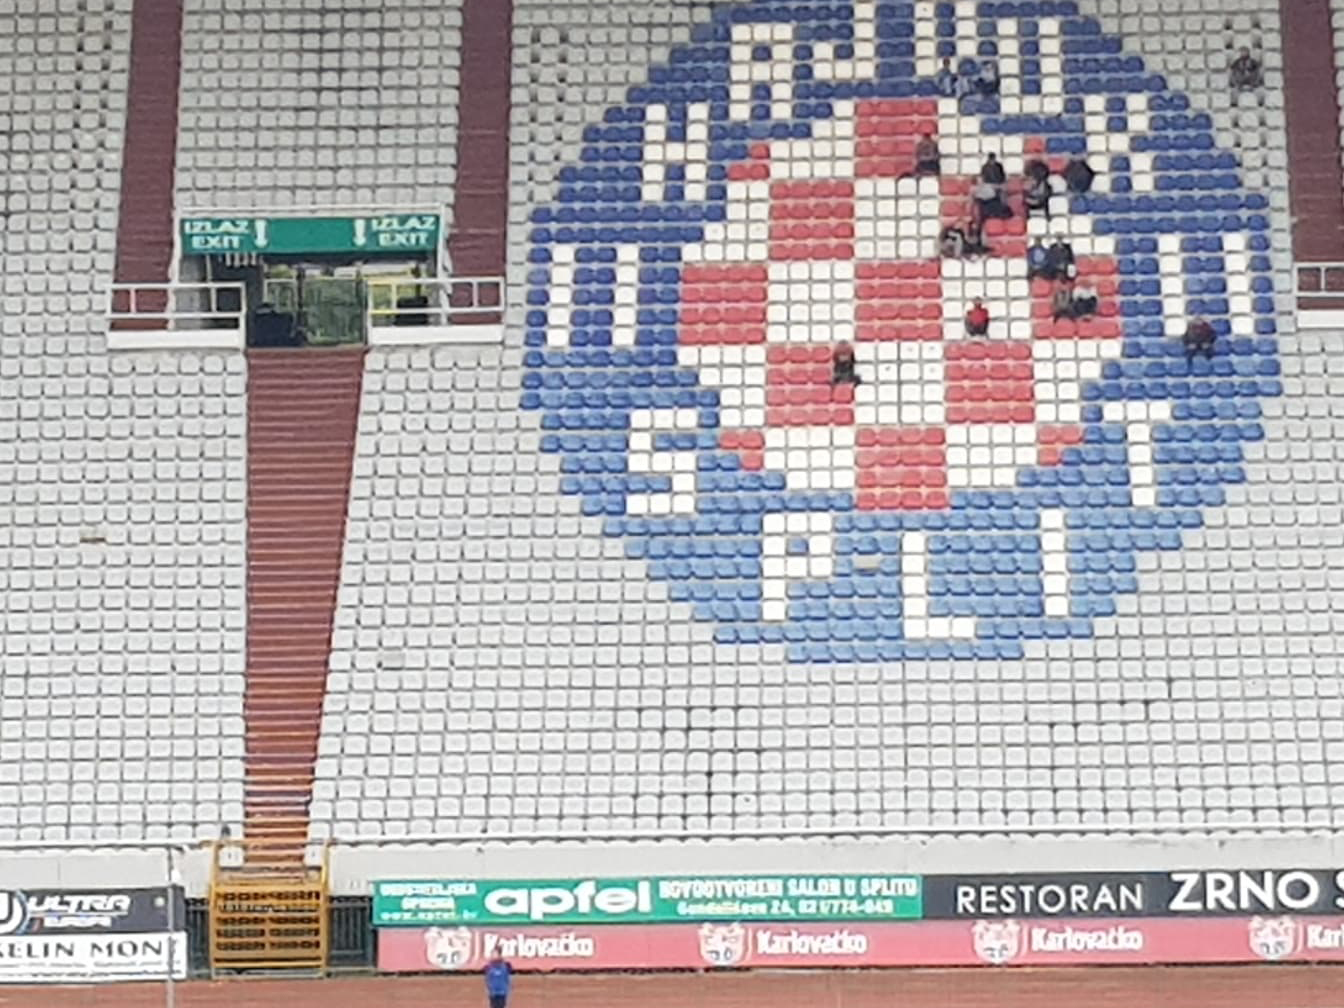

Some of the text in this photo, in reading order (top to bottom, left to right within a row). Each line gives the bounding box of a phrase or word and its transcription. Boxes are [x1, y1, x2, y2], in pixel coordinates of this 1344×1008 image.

[184, 220, 249, 234] IZLAZ
[372, 217, 436, 231] IZLAZ
[191, 235, 242, 249] EXIT
[379, 232, 429, 246] EXIT
[658, 877, 918, 899] NOVOOTVORENI SALON U SPLITU
[957, 883, 1144, 914] RESTORAN
[1169, 871, 1321, 911] ZRNO
[27, 895, 132, 915] ULTRA
[484, 880, 652, 921] apfel
[756, 928, 868, 955] Karlovačko
[1031, 925, 1145, 952] Karlovačko
